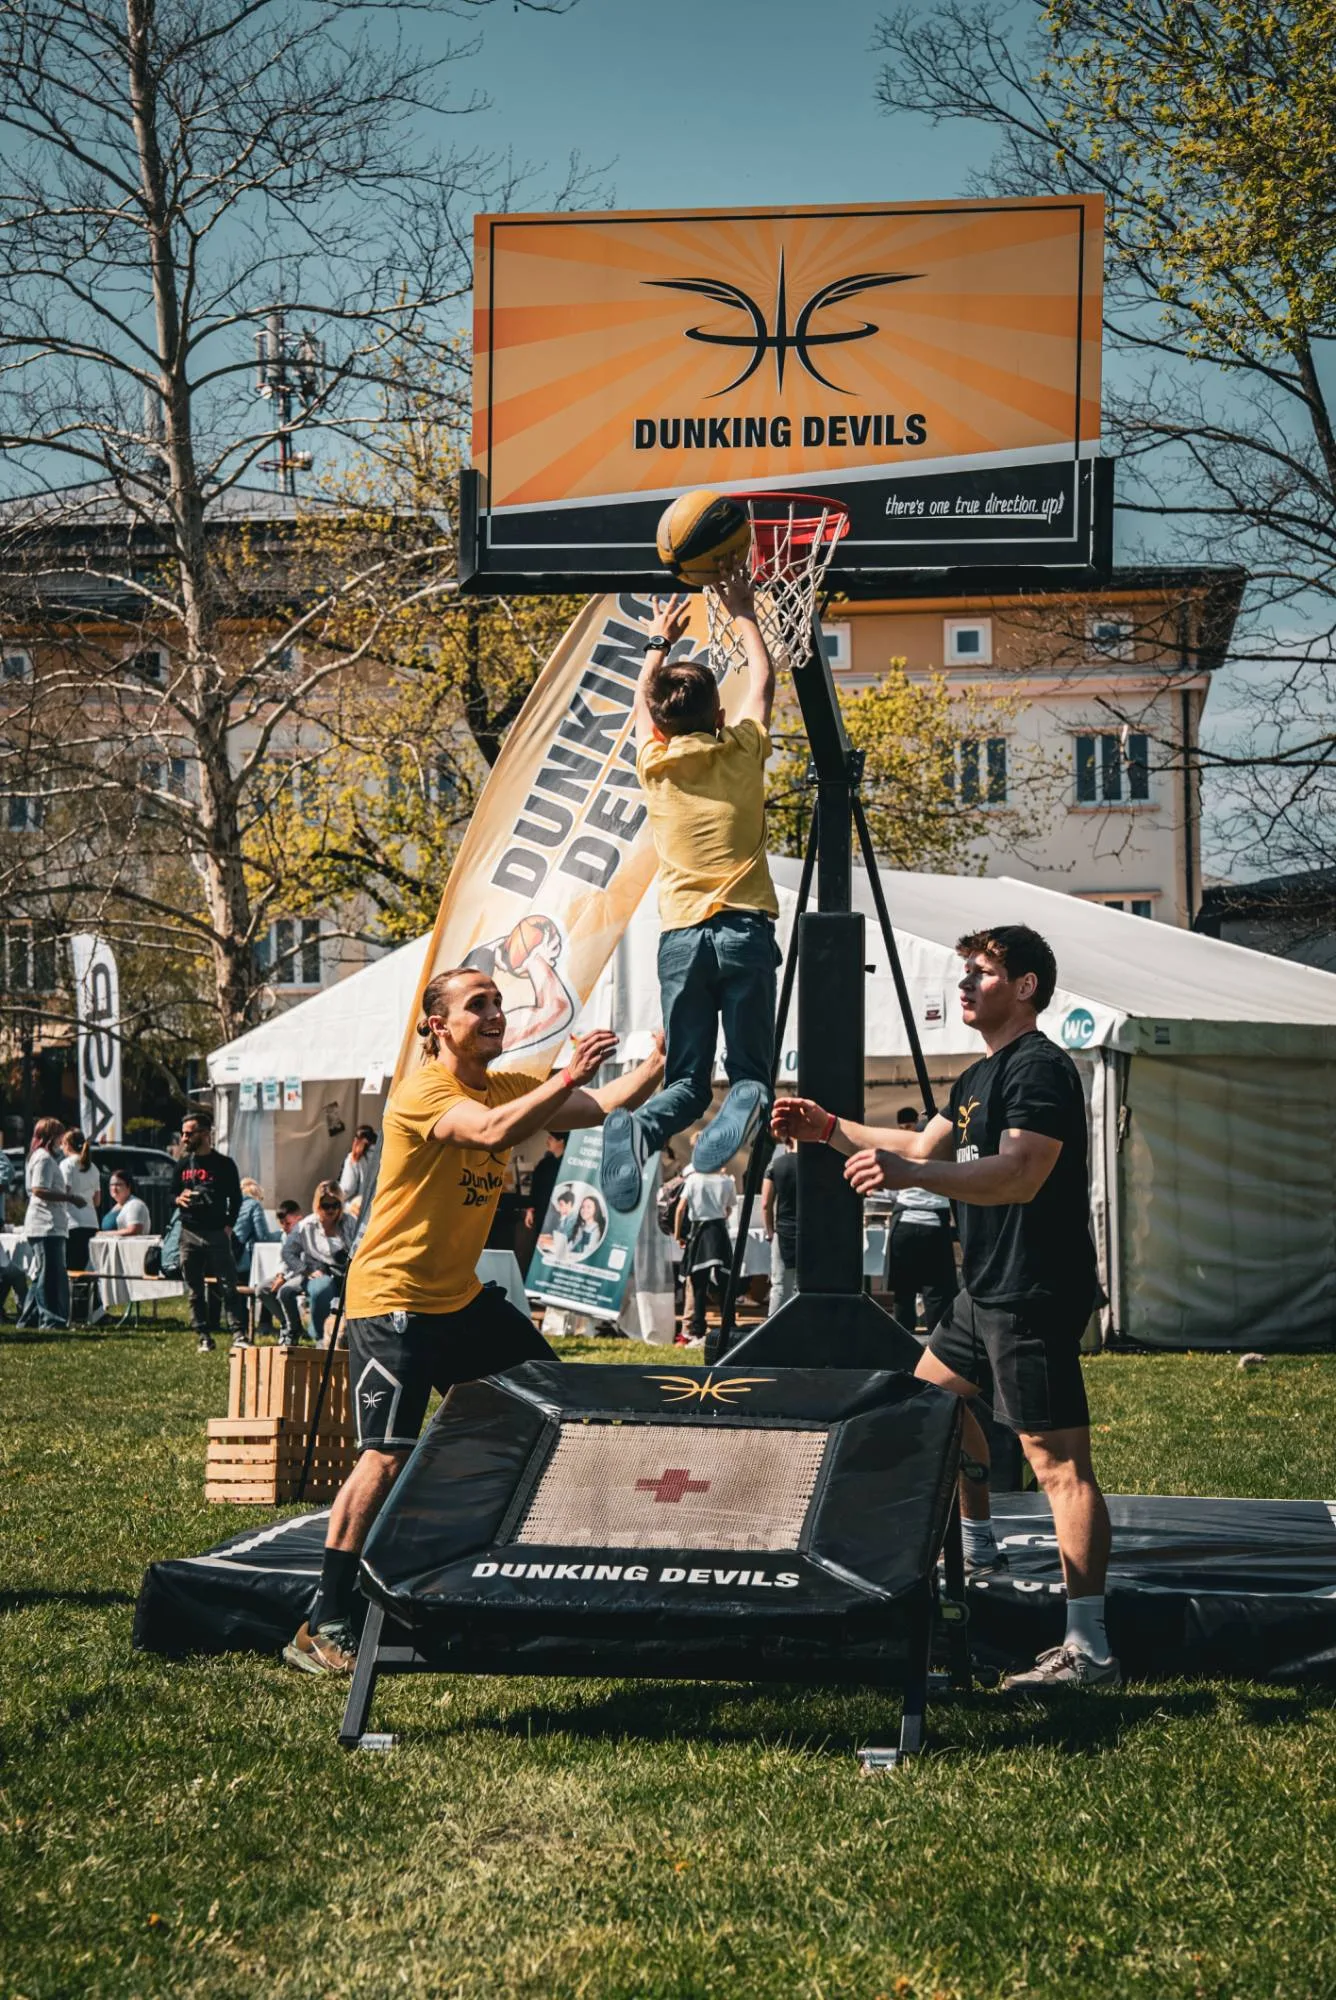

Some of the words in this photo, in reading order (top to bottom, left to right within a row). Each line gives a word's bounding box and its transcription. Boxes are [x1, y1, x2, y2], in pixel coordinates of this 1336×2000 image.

[634, 415, 792, 449] DUNKING
[803, 413, 928, 447] DEVILS
[885, 494, 925, 516] there's
[929, 500, 951, 516] one
[955, 496, 981, 515] true
[1063, 1019, 1093, 1040] WC
[471, 1562, 650, 1582] DUNKING
[658, 1567, 801, 1588] DEVILS
